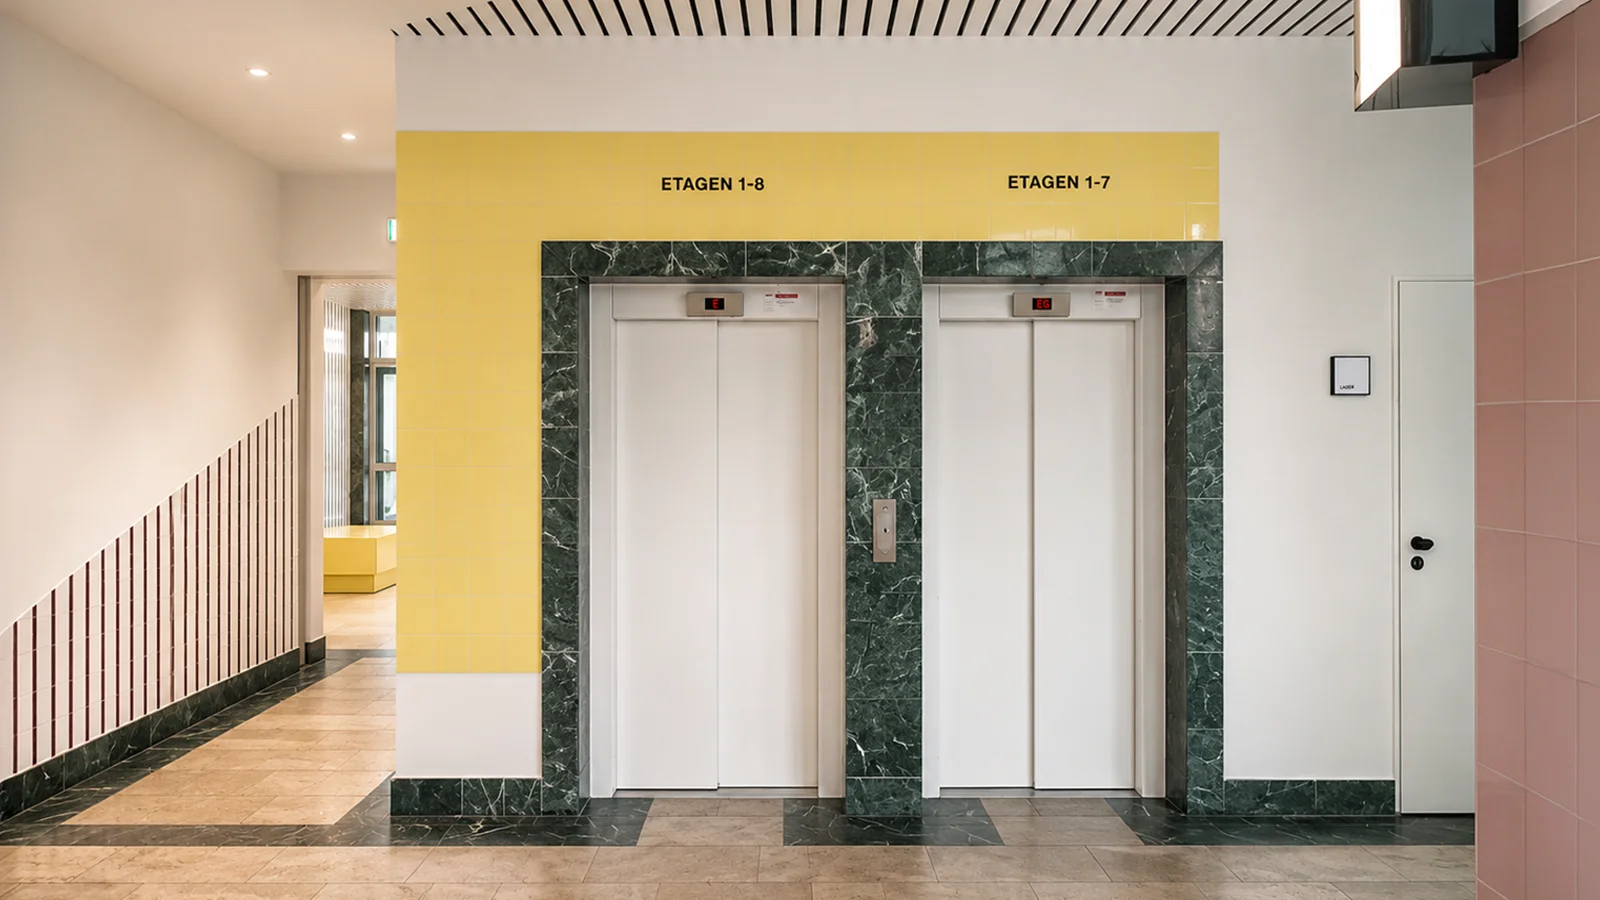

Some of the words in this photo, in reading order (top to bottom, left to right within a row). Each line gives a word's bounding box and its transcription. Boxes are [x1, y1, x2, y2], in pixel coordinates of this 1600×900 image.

[661, 177, 732, 191] ETAGEN
[738, 177, 765, 191] 1-8
[1008, 175, 1079, 189] ETAGEN
[1085, 175, 1110, 189] 1-7
[1036, 299, 1050, 309] EG
